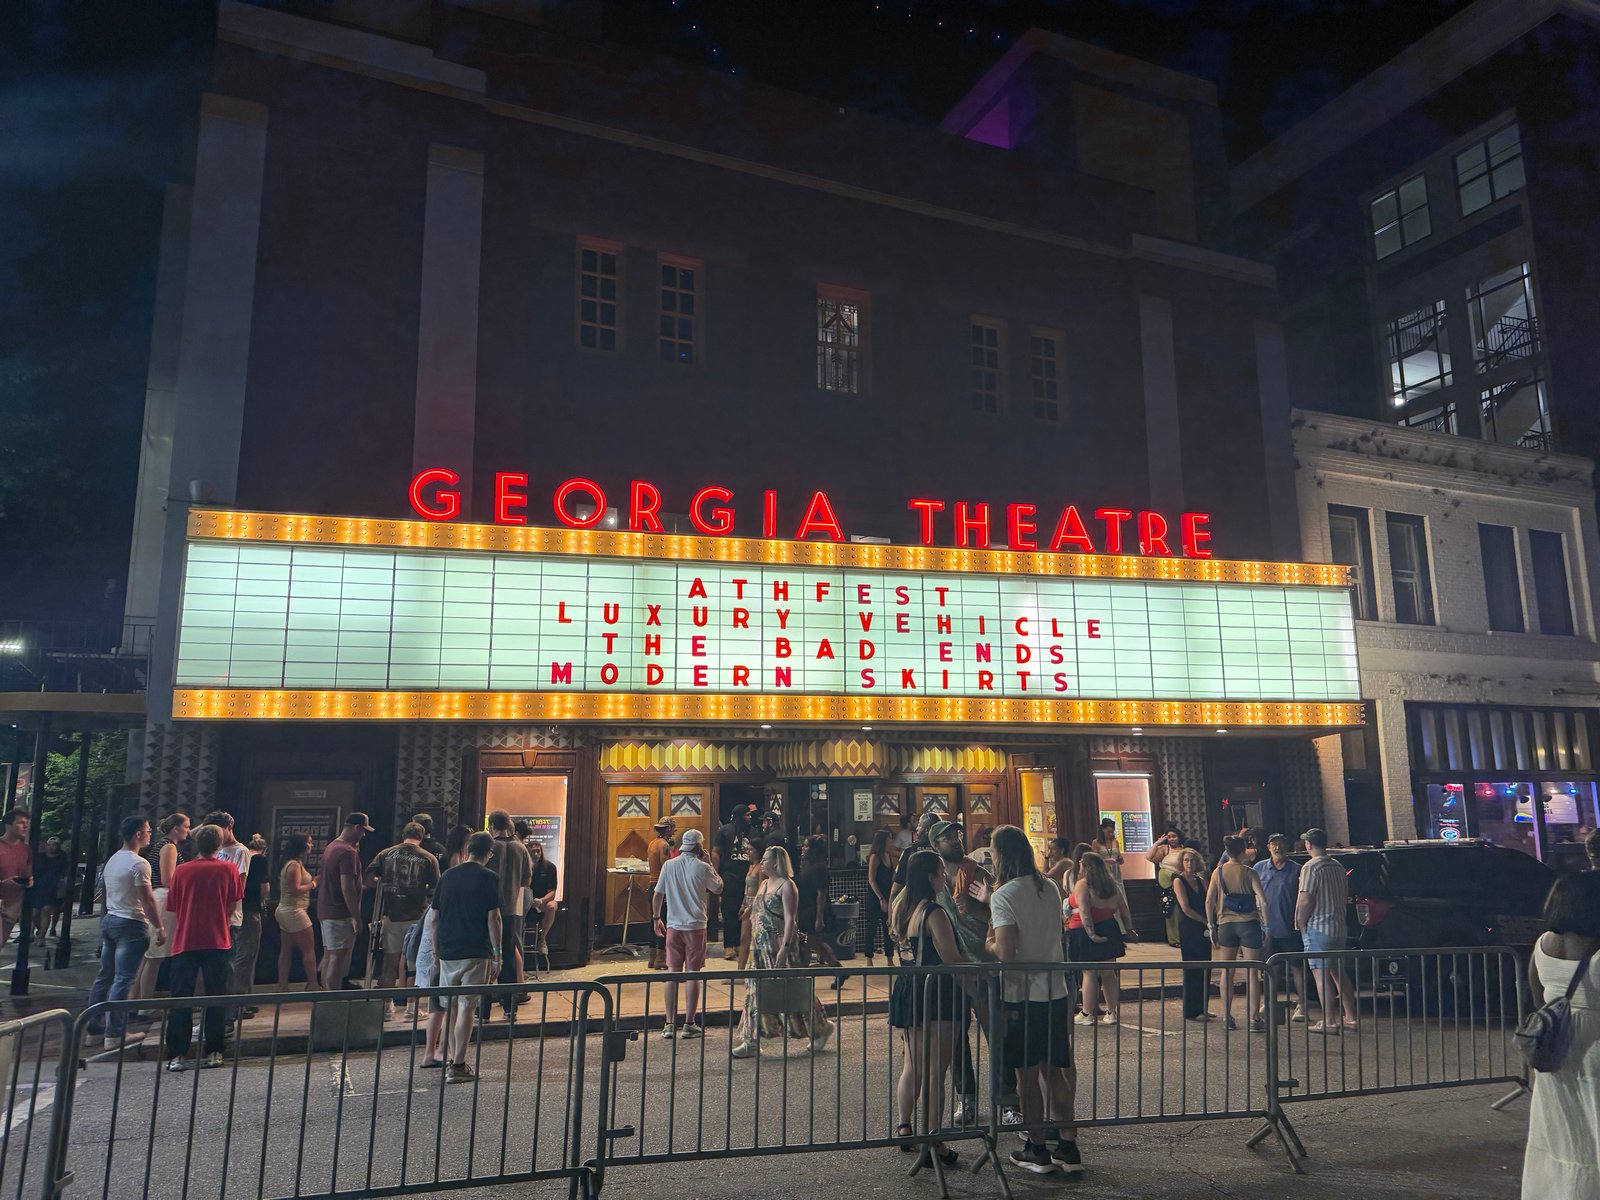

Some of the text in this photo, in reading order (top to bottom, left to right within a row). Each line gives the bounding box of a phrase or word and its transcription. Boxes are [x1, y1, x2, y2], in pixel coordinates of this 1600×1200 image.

[408, 467, 1214, 559] GEORGIA THEATRE
[687, 577, 950, 607] ATHFEST
[557, 600, 1101, 640] LUXURY VEHICLE
[601, 632, 1066, 665] THE BAD ENDS
[550, 661, 1069, 693] MODERN SKIRTS
[416, 776, 443, 788] 215
[730, 853, 750, 861] CAS
